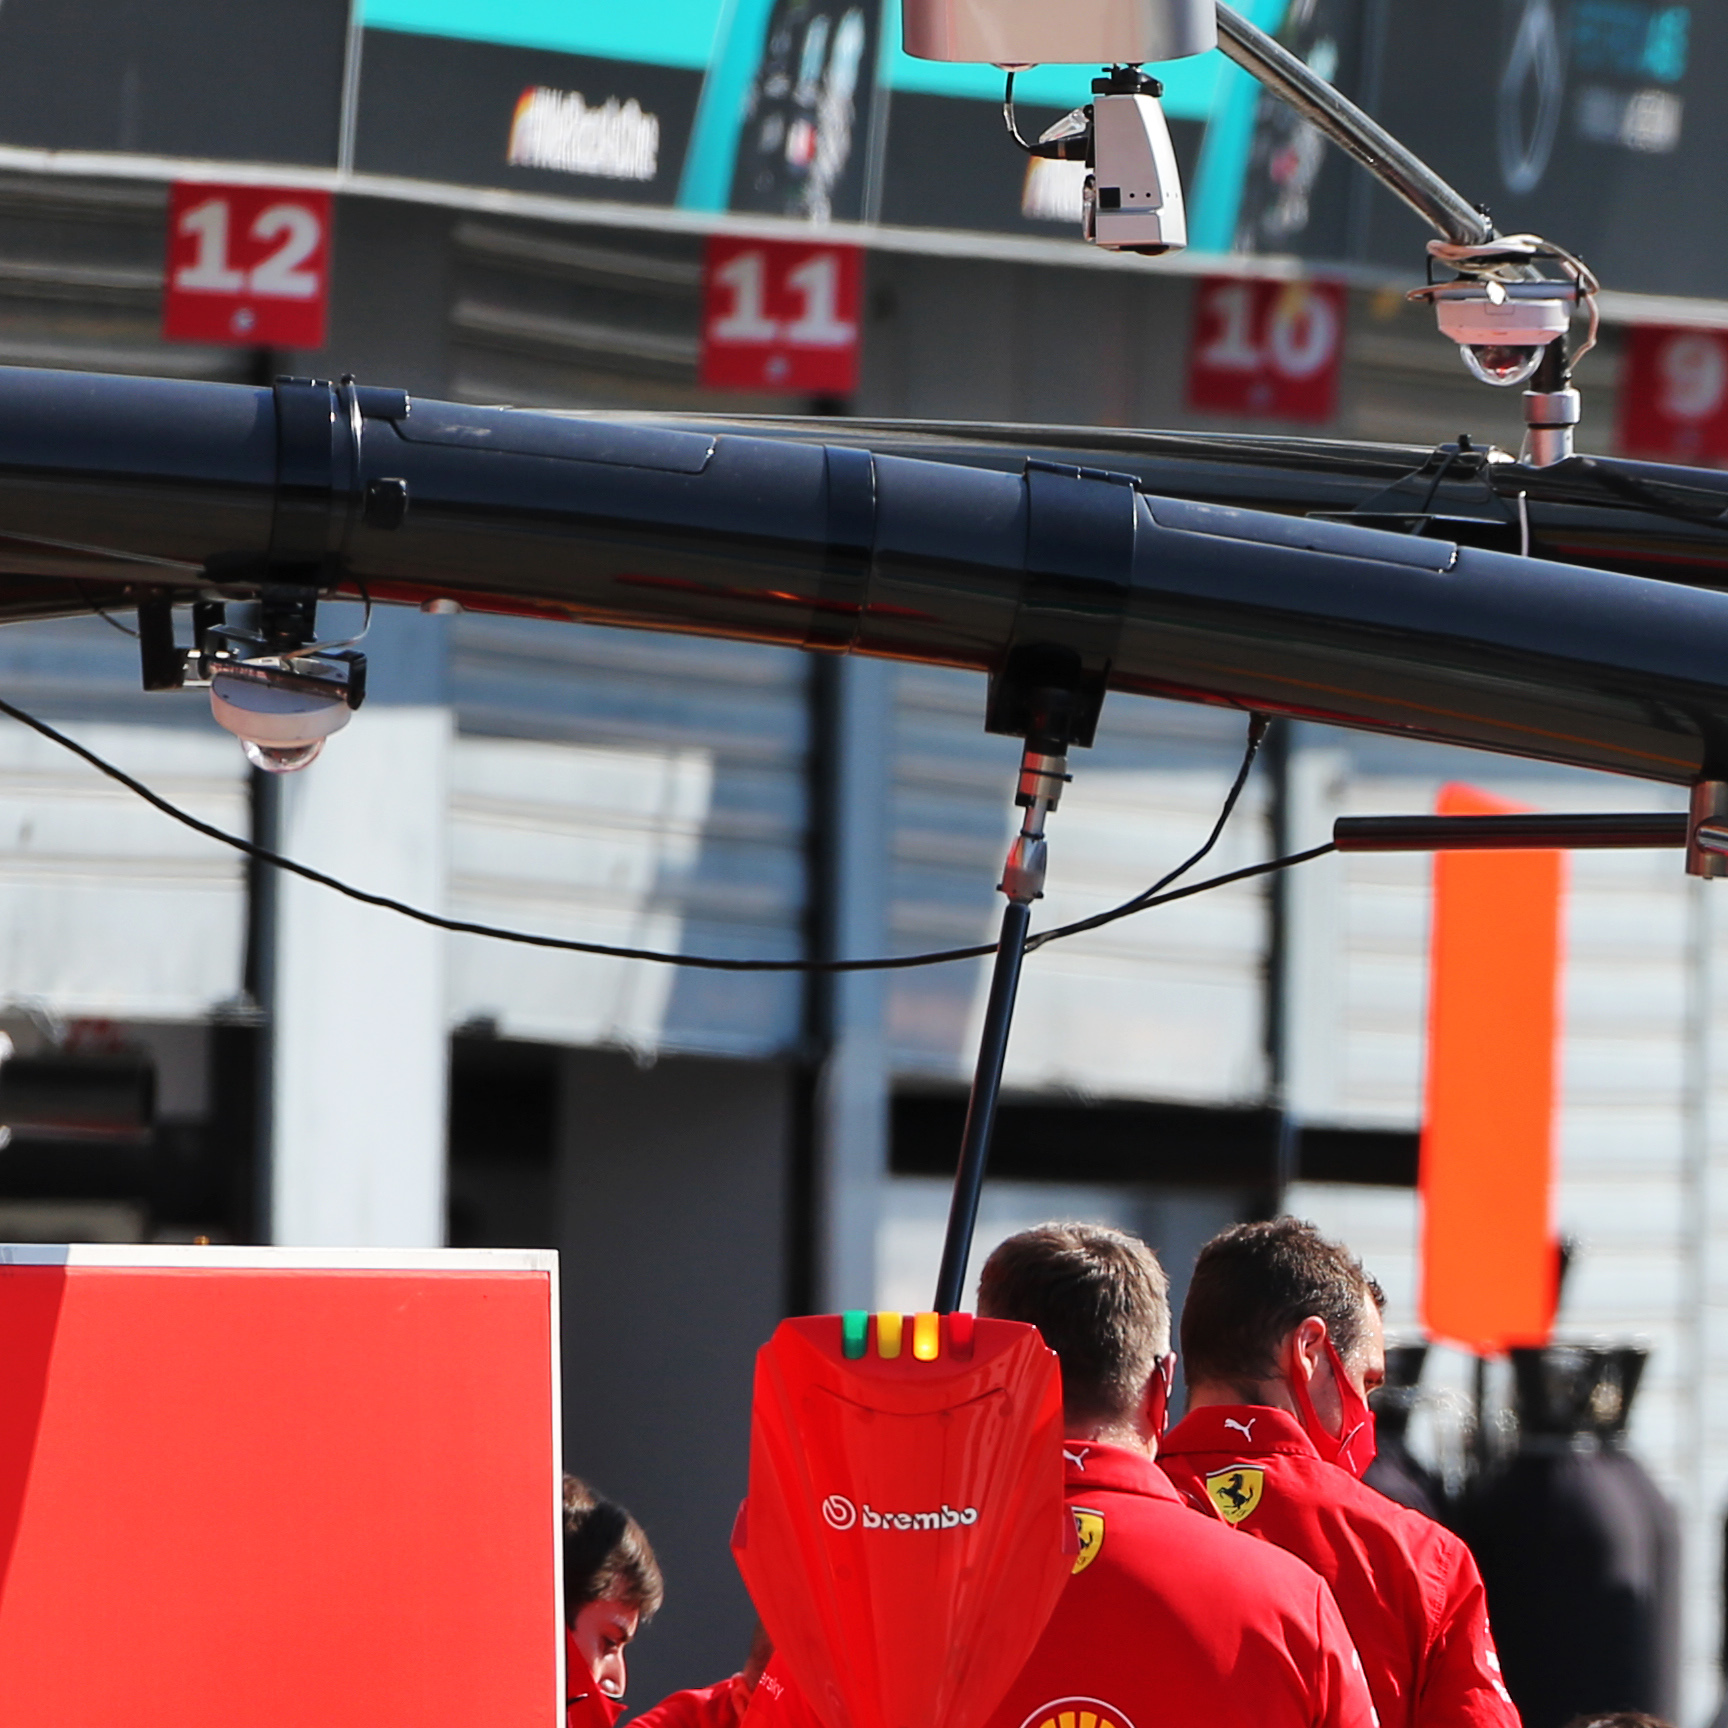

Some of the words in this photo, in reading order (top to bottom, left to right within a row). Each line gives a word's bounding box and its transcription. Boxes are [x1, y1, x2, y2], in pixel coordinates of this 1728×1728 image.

[174, 199, 322, 299] 12
[708, 250, 859, 346] 11
[1205, 285, 1337, 379] 10
[862, 1504, 979, 1531] brembo
